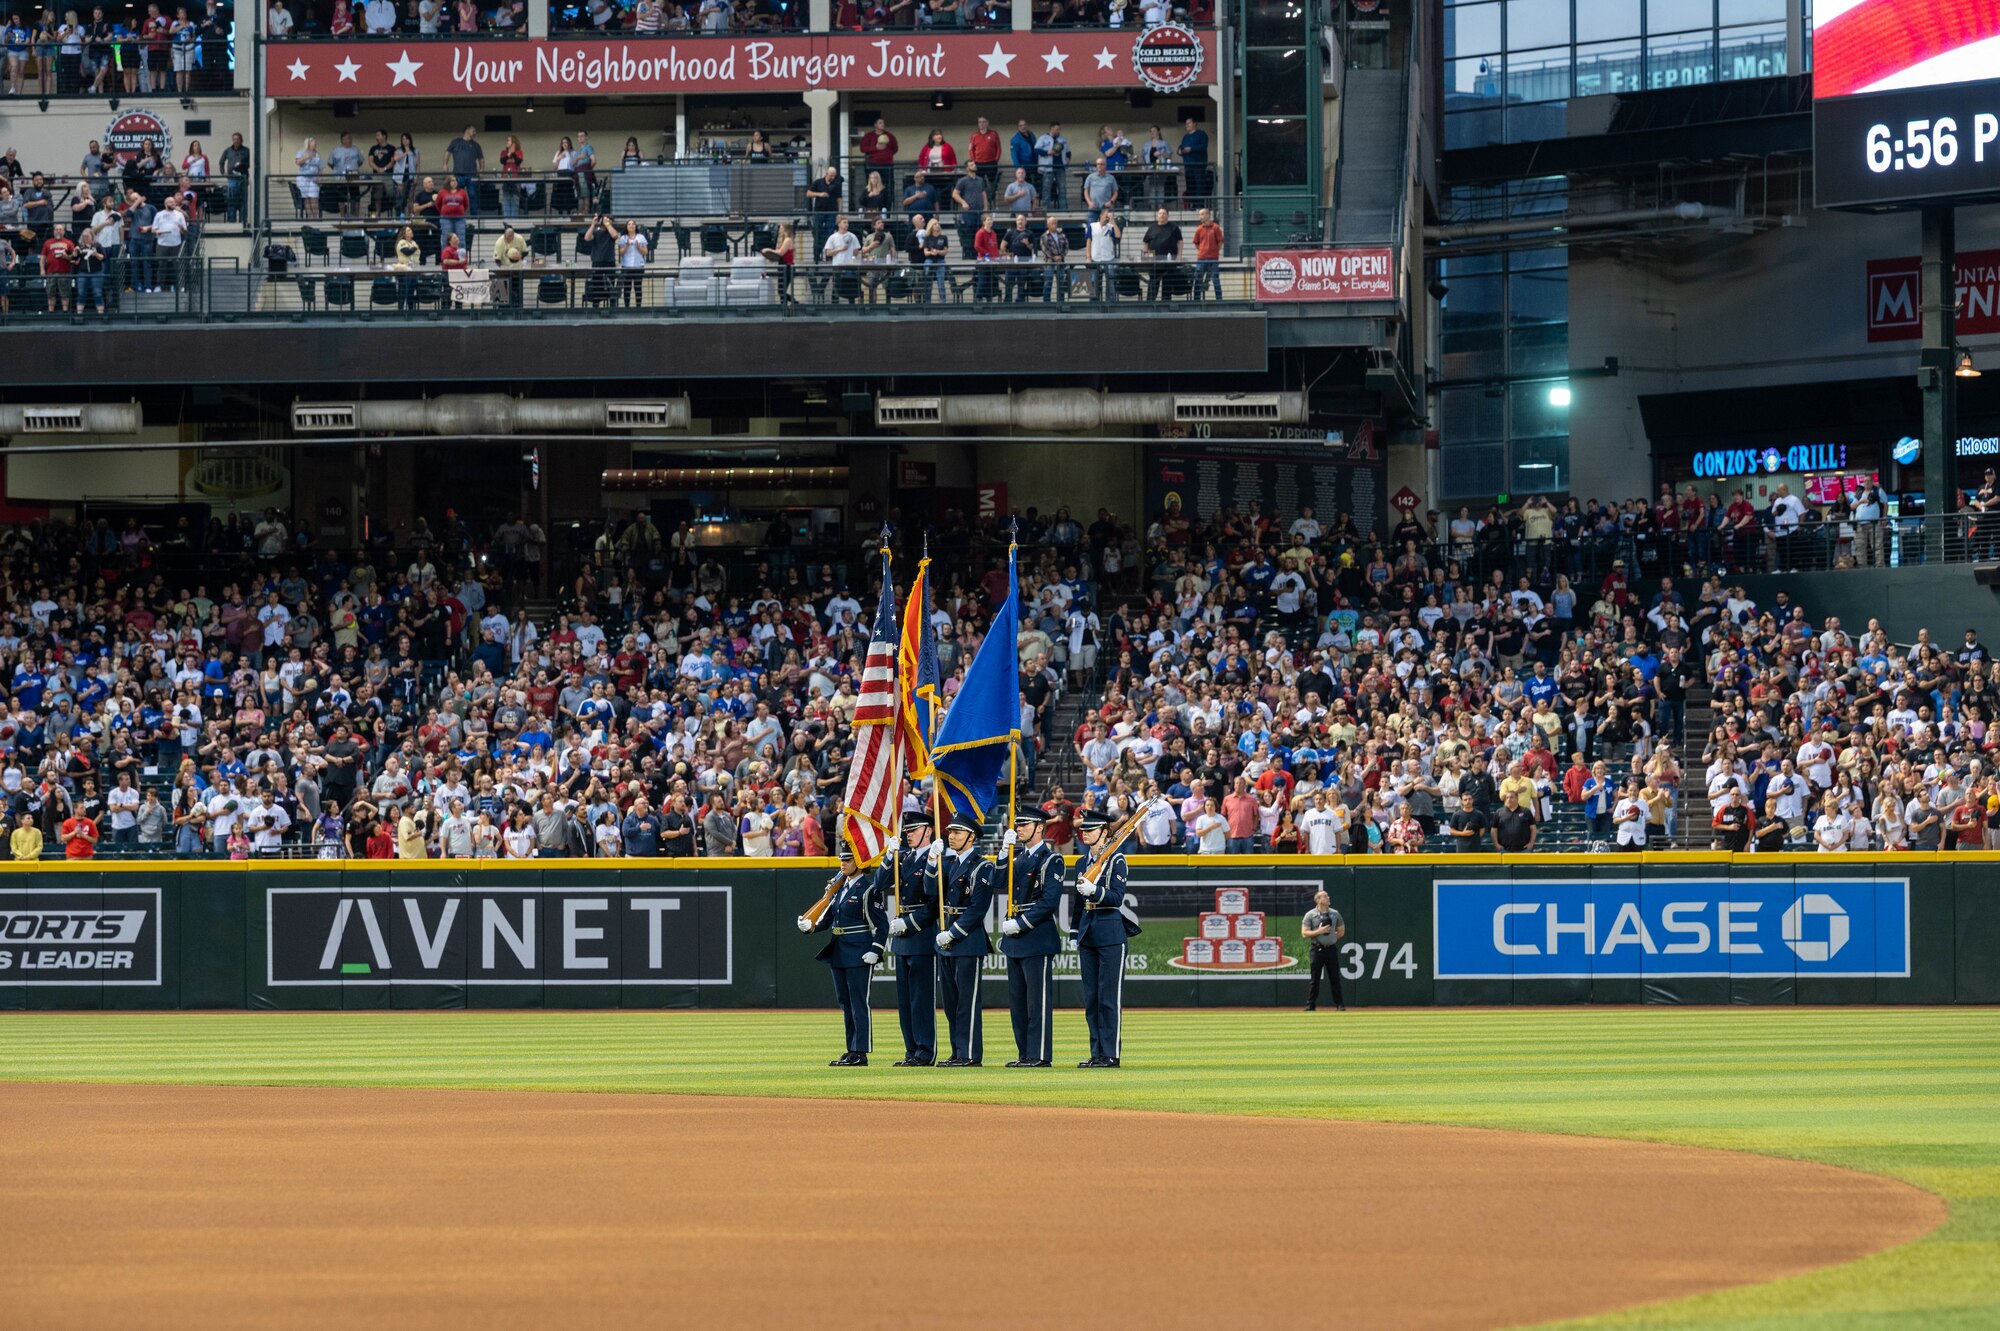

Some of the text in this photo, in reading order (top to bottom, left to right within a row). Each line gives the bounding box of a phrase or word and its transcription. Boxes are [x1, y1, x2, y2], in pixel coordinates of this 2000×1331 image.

[1163, 48, 1189, 56] BEERS
[453, 38, 946, 91] Your Neighborhood Burger Joint
[110, 134, 131, 142] COLD
[1867, 117, 1958, 173] 6:56
[1301, 257, 1336, 277] NOW
[1341, 256, 1387, 275] OPEN!
[1297, 278, 1321, 290] Game
[1322, 278, 1340, 293] Day
[1351, 277, 1389, 293] Everyday
[1962, 437, 1999, 455] MOON
[1693, 443, 1838, 477] GONZO'S GRILL
[860, 502, 874, 511] 141
[1397, 496, 1414, 506] 142
[325, 507, 342, 516] 140
[319, 898, 680, 973] AVNET
[1493, 902, 1764, 955] CHASE
[20, 951, 134, 969] LEADER
[1340, 942, 1418, 980] 374
